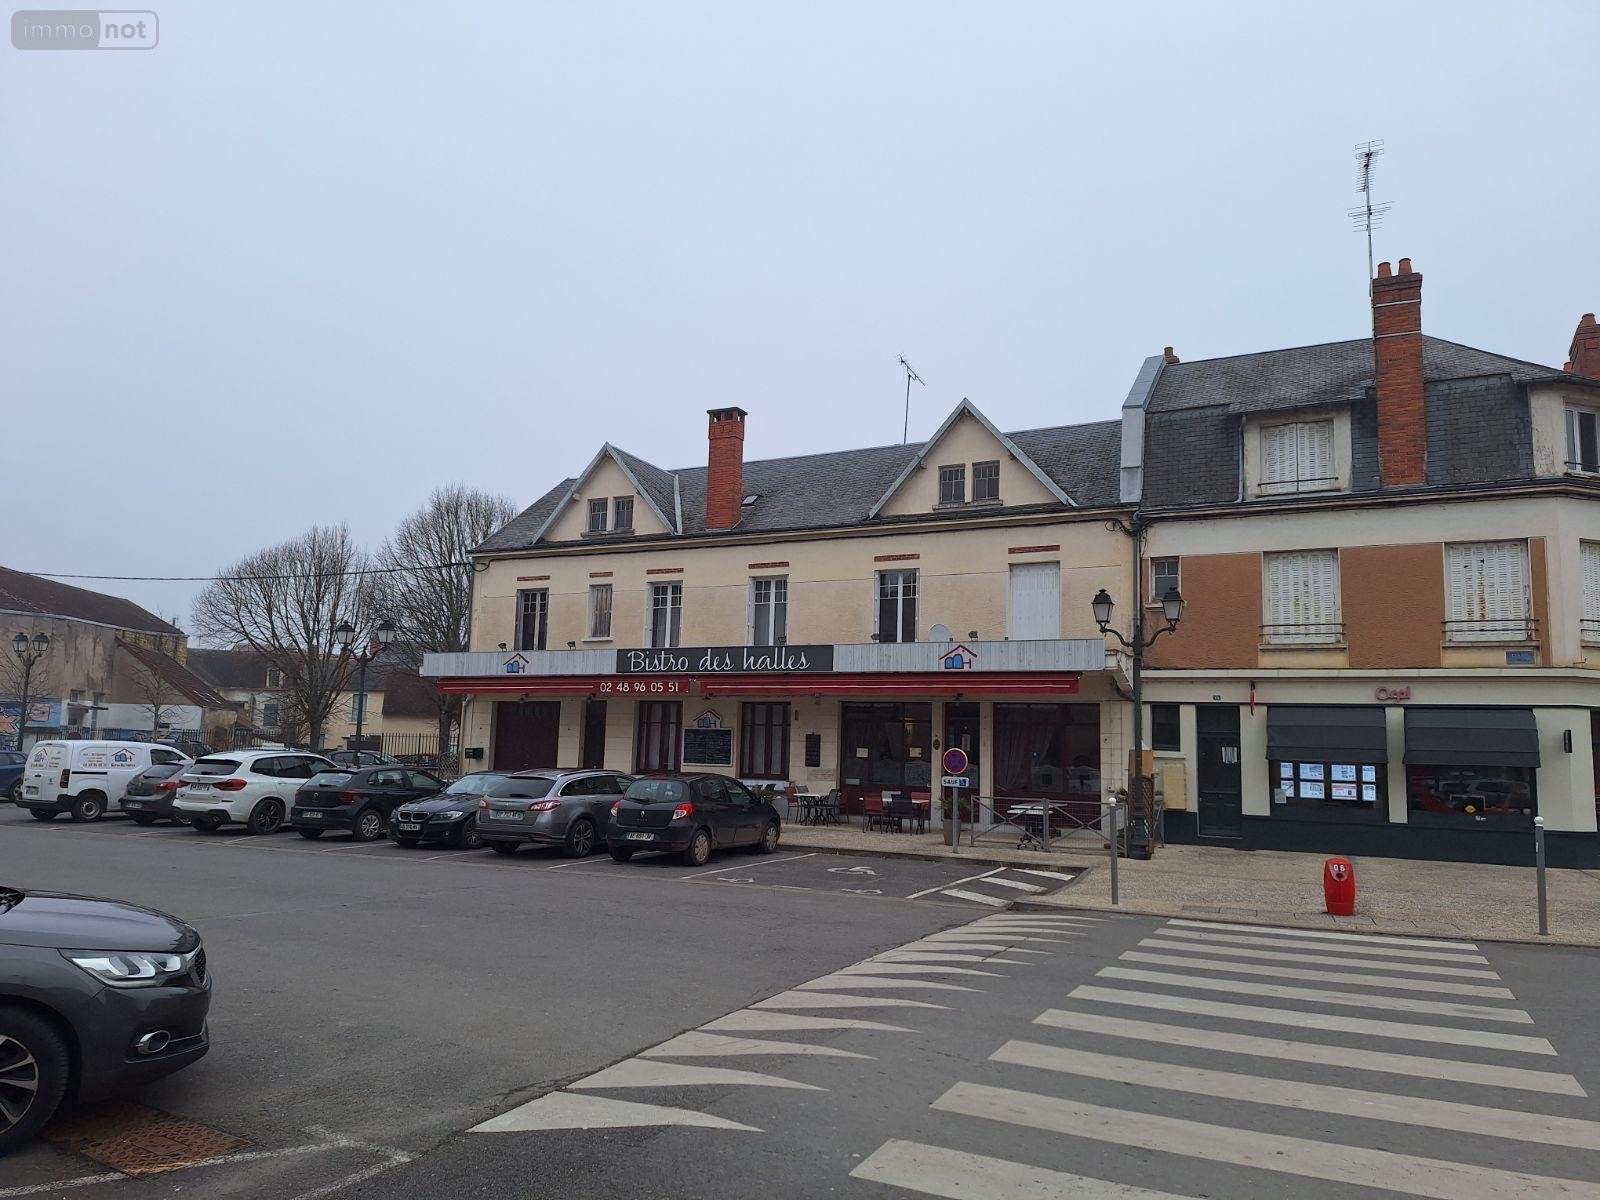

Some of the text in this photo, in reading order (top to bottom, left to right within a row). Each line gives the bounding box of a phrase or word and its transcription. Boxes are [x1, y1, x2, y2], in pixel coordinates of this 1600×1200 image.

[627, 646, 811, 672] Bistro des halles
[600, 682, 679, 692] 02 48 96 05 51
